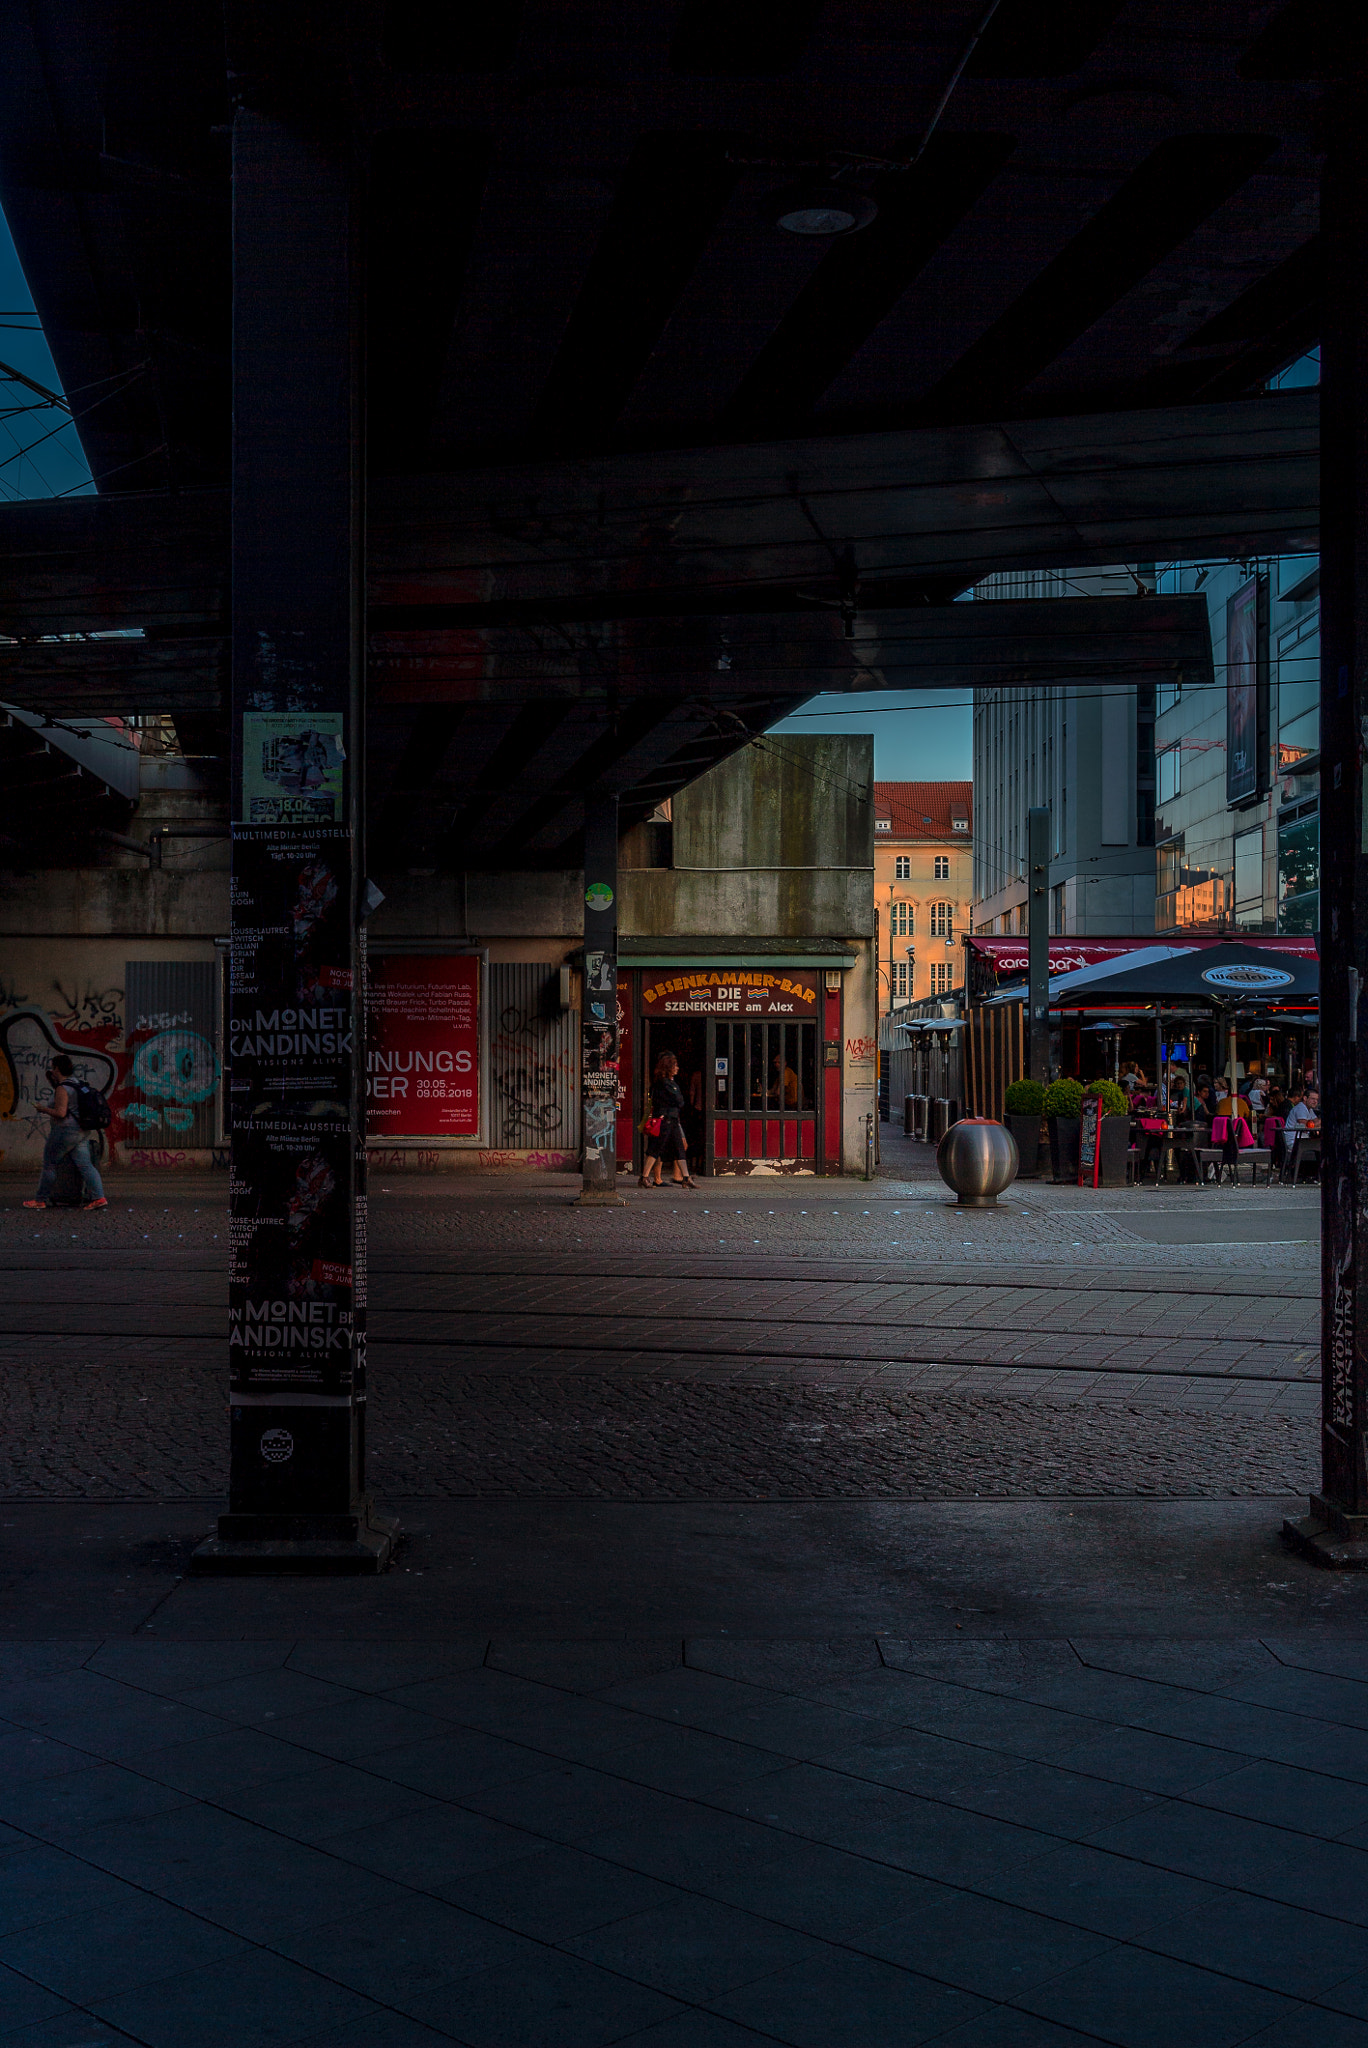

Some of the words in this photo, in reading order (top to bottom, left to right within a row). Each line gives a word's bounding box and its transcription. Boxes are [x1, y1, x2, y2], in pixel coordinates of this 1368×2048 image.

[1210, 972, 1286, 981] Warsteiner
[643, 972, 816, 1004] BESENKAMMER-BAR
[717, 987, 742, 1000] DIE
[664, 1001, 740, 1013] SZENEKNEIPE
[745, 1003, 762, 1013] am
[768, 1001, 794, 1013] Alex
[256, 1007, 347, 1031] MONET
[257, 1058, 304, 1066] VISIONS
[312, 1057, 343, 1065] ALIVE
[416, 1079, 448, 1089] 30.05.
[416, 1089, 473, 1099] 09.06.2018
[245, 1300, 337, 1323] MONET
[243, 1350, 292, 1359] VISIONS
[300, 1351, 330, 1359] ALIVE
